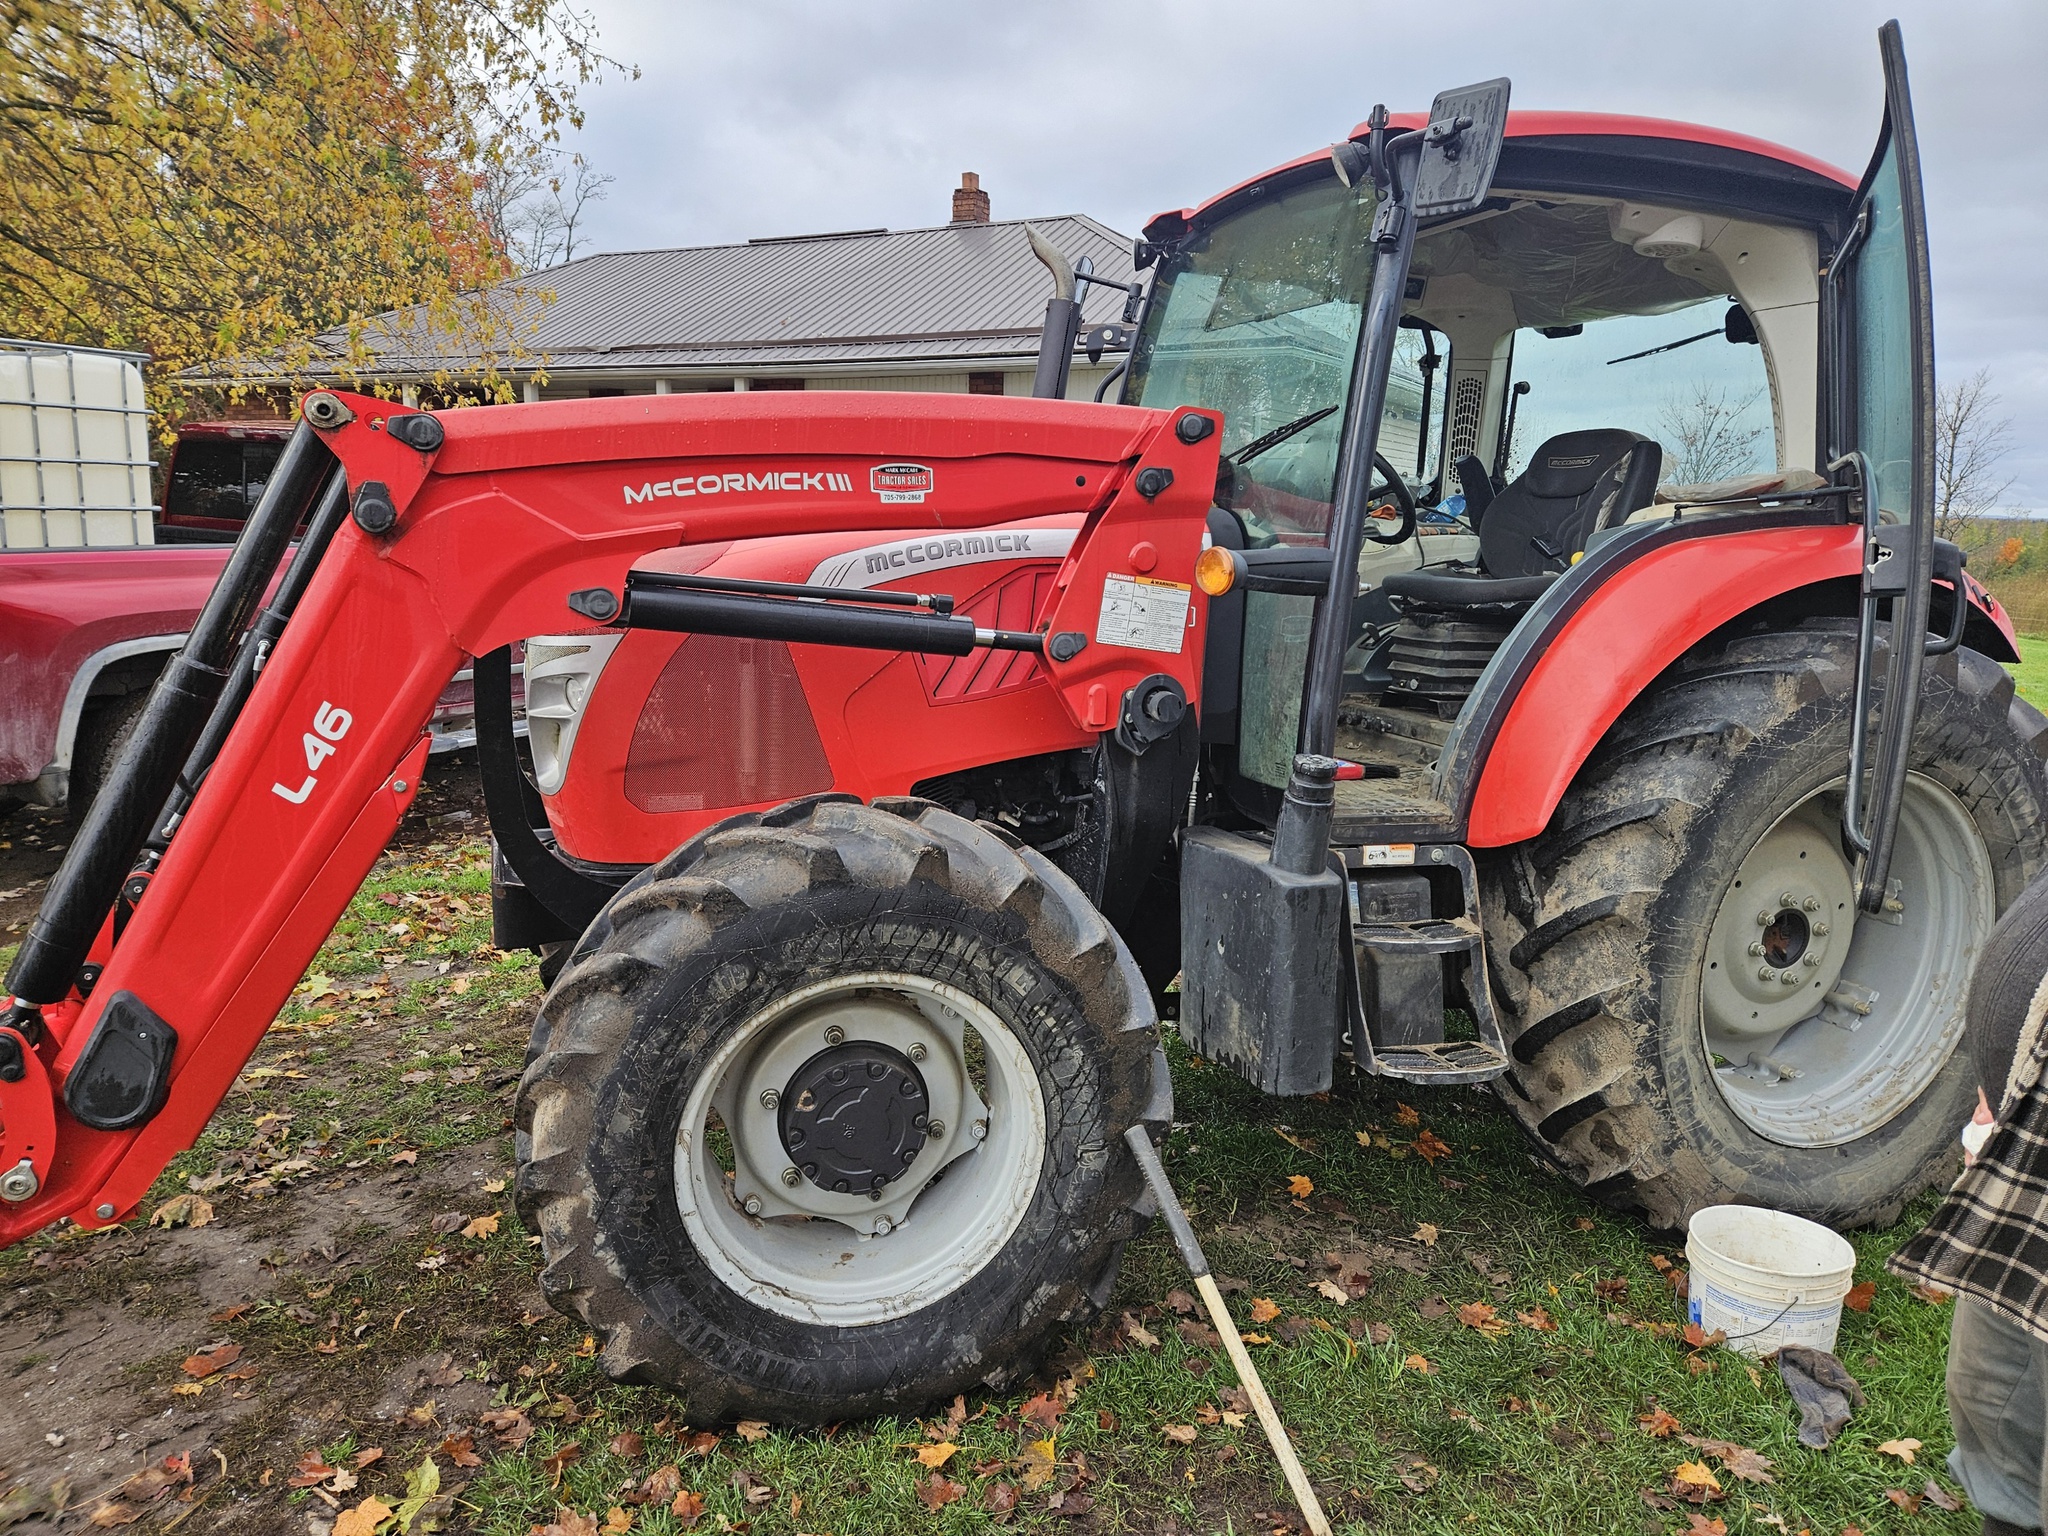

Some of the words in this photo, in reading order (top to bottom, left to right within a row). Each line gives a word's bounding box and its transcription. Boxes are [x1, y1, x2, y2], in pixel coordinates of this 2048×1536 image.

[878, 475, 906, 485] TRACTOR
[907, 475, 926, 485] SALES
[1112, 574, 1134, 582] DANGER
[1154, 580, 1178, 588] WARNING
[271, 700, 352, 804] L46
